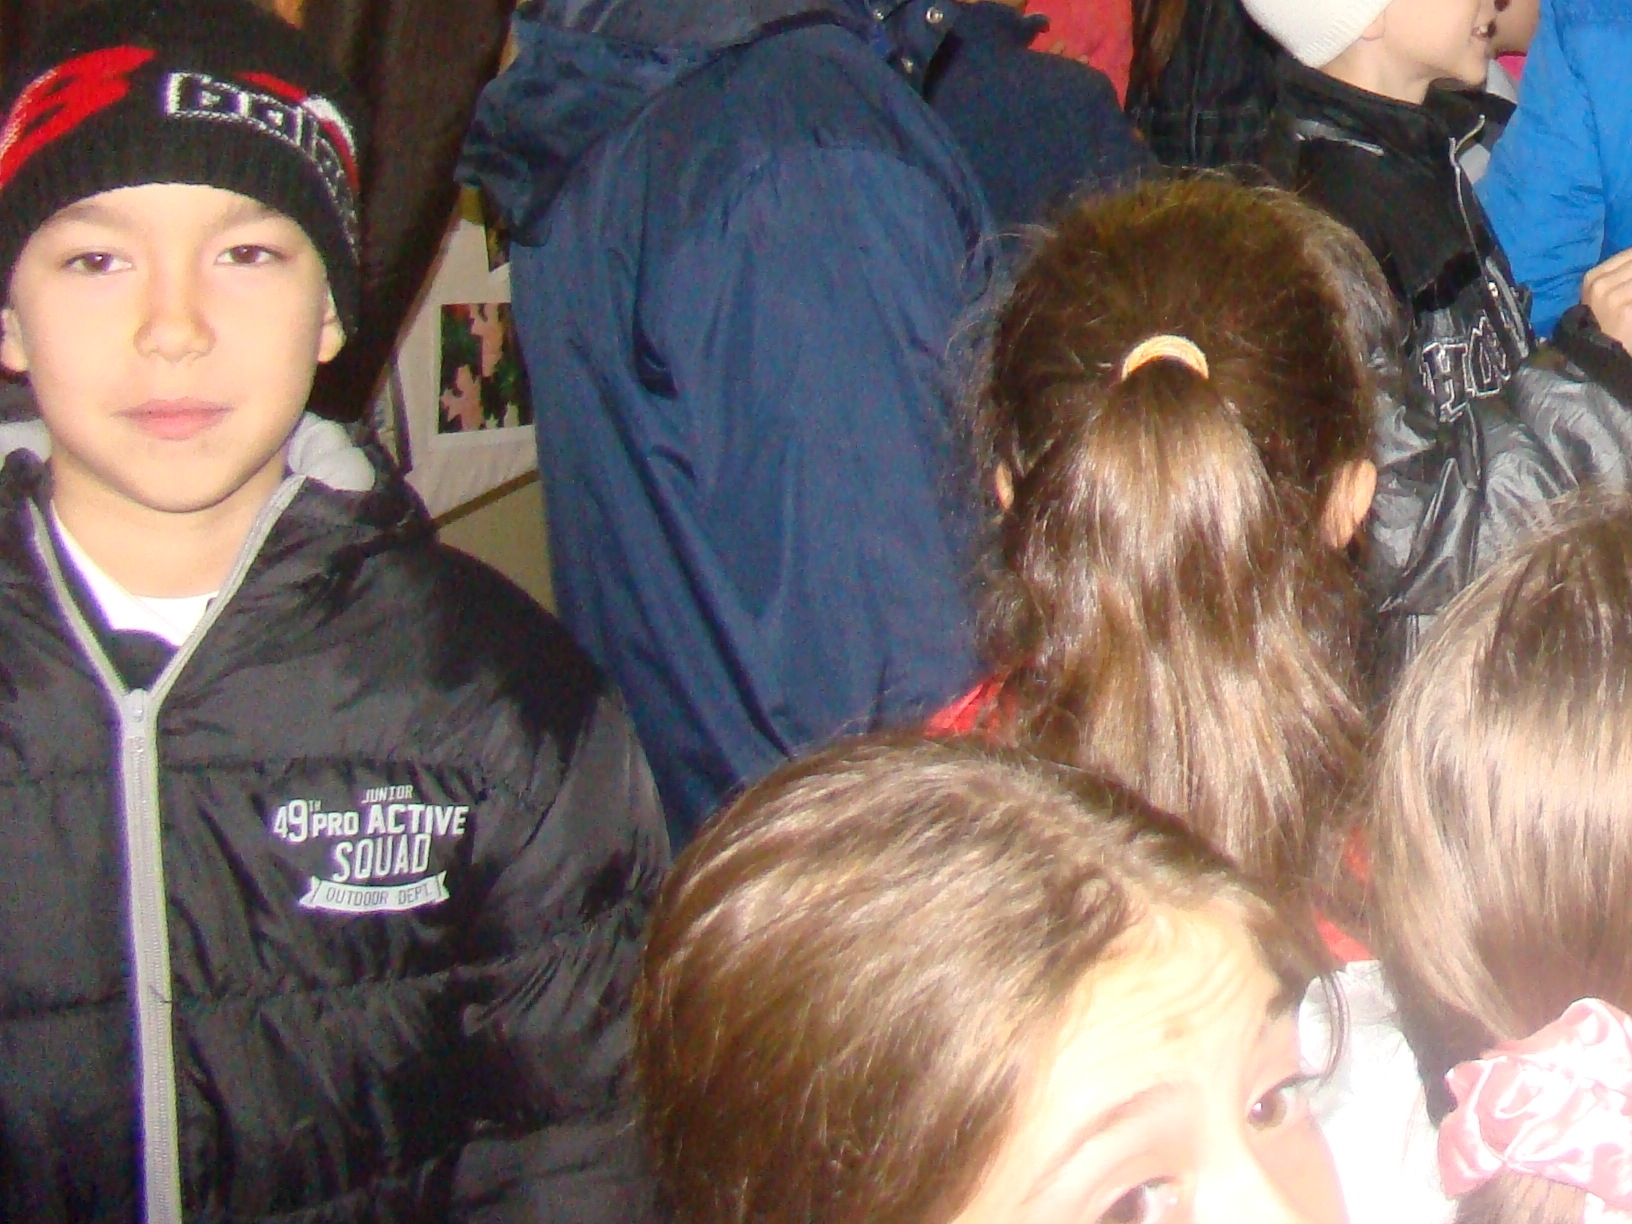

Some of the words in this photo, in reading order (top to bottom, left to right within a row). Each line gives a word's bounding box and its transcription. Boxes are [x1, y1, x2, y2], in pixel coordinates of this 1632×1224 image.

[361, 785, 414, 804] JUNIOR
[312, 811, 359, 838] PRO
[367, 803, 470, 836] ACTIVE
[332, 833, 432, 883] SQUAD
[325, 886, 389, 907] OUTDOOR
